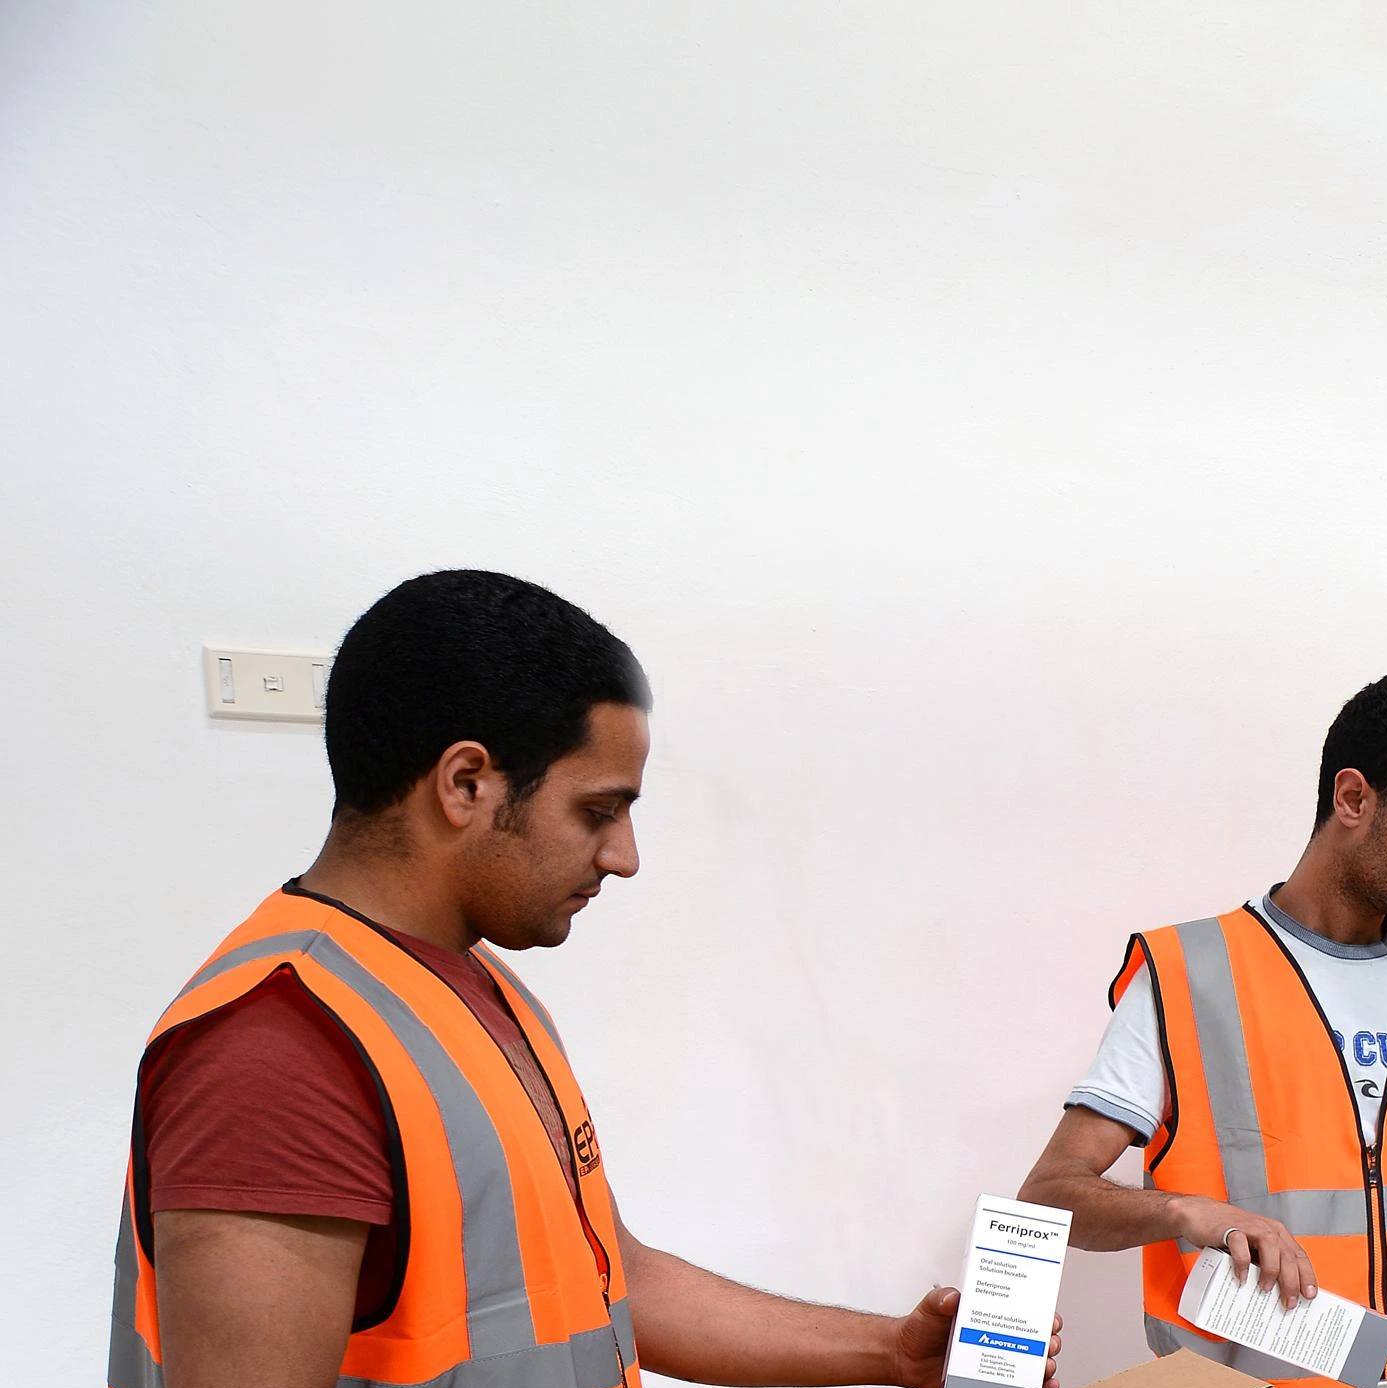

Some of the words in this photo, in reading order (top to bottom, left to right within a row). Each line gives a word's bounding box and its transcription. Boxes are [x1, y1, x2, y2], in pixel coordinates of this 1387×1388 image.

[980, 1257, 994, 1266] Oral
[994, 1260, 1017, 1270] solution
[979, 1265, 1004, 1275] Solution
[1004, 1269, 1028, 1279] buvable
[976, 1280, 1011, 1291] Deferiprone
[971, 1309, 982, 1317] 500
[1003, 1315, 1027, 1325] solution
[991, 1321, 1015, 1331] solution
[1015, 1325, 1039, 1334] buvable
[990, 1340, 1016, 1349] APOTEX
